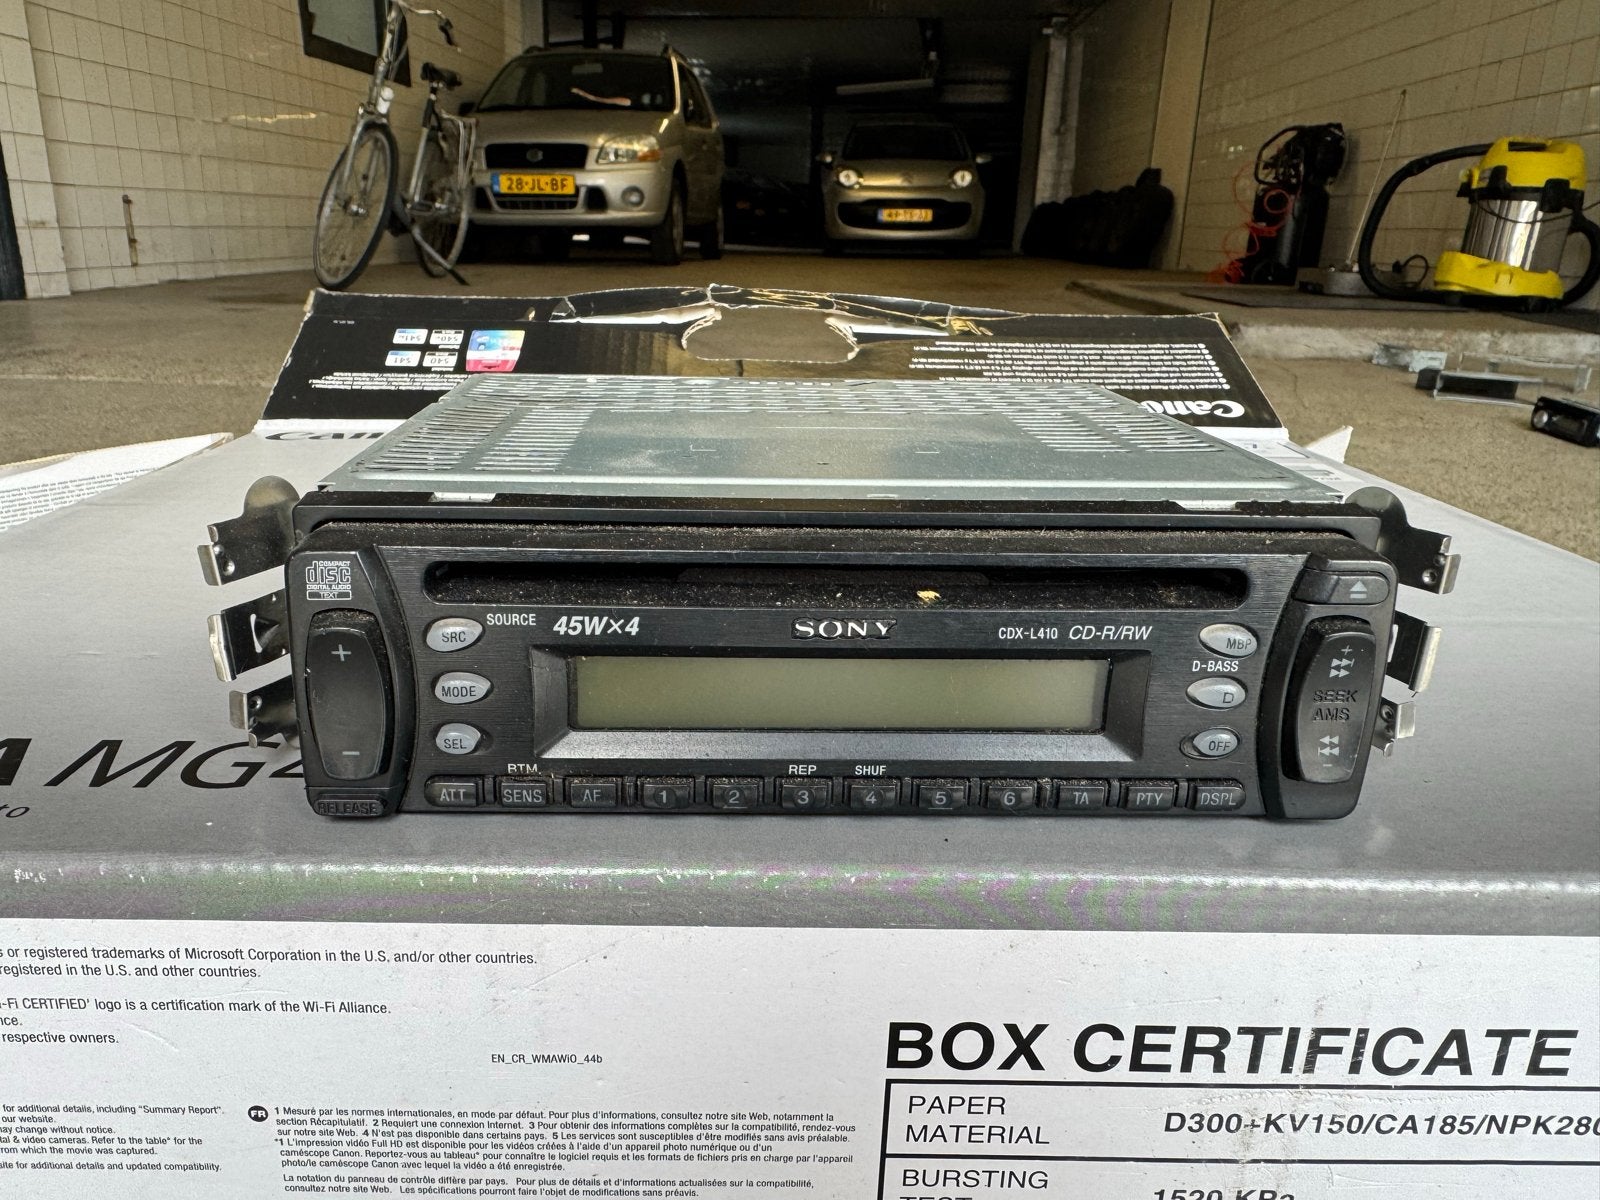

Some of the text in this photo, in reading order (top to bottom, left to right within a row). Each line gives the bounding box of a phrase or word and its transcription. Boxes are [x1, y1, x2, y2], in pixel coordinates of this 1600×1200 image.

[486, 613, 536, 626] SOURCE
[794, 620, 895, 638] SONY
[998, 626, 1153, 640] CDX-L410 CD-R/RW
[442, 631, 466, 643] SRC
[1226, 638, 1252, 650] MBP
[1192, 660, 1239, 672] D-BASS
[442, 685, 476, 698] MODE
[1222, 692, 1234, 704] D
[1314, 690, 1358, 703] SEEK
[1313, 708, 1350, 721] AMS
[444, 738, 467, 749] SEL
[1208, 740, 1231, 752] OFF
[788, 764, 817, 775] REP
[854, 765, 887, 776] SHUF
[440, 788, 466, 802] ATT
[504, 790, 543, 803] SENS
[583, 790, 602, 801] AF
[659, 791, 667, 803] 1
[728, 791, 740, 804] 2
[798, 790, 809, 804] 3
[866, 792, 877, 805] 4
[935, 792, 947, 805] 5
[1004, 794, 1016, 806] 6
[1073, 792, 1089, 805] TA
[1136, 792, 1163, 806] PTY
[1200, 794, 1237, 806] DSPL
[318, 802, 378, 814] RELEASE
[7, 949, 21, 958] or
[23, 946, 89, 961] registered
[90, 946, 166, 959] trademarks
[168, 947, 181, 960] of
[184, 948, 245, 960] Microsoft
[247, 948, 322, 964] Corporation
[325, 949, 337, 961] in
[339, 949, 361, 962] the
[364, 950, 391, 962] U.S.
[393, 950, 436, 962] and/or
[438, 950, 472, 963] other
[475, 951, 538, 964] countries.
[65, 964, 78, 976] in
[80, 964, 102, 976] the
[104, 964, 132, 976] U.S.
[134, 964, 159, 976] and
[162, 964, 195, 977] other
[198, 965, 261, 977] countries.
[94, 998, 122, 1013] logo
[124, 998, 137, 1010] is
[139, 1002, 148, 1011] a
[151, 998, 225, 1011] certification
[228, 999, 262, 1012] mark
[264, 1000, 277, 1012] of
[279, 1000, 301, 1012] the
[302, 1000, 336, 1013] Wi-Fi
[338, 1001, 392, 1013] Alliance.
[1, 1030, 119, 1046] respective owners.
[886, 1022, 1579, 1077] BOX CERTIFICATE
[2, 1103, 16, 1112] for
[17, 1104, 61, 1113] additional
[62, 1104, 95, 1115] details,
[96, 1104, 137, 1115] including
[908, 1096, 1006, 1115] PAPER
[18, 1114, 57, 1123] website.
[274, 1107, 280, 1115] 1
[282, 1107, 317, 1116] Mesuré
[318, 1109, 334, 1118] par
[335, 1107, 350, 1116] les
[471, 1109, 498, 1117] mode
[498, 1111, 514, 1120] par
[515, 1109, 547, 1118] défaut.
[548, 1109, 570, 1118] Pour
[571, 1110, 591, 1120] plus
[705, 1111, 729, 1120] notre
[730, 1111, 747, 1120] site
[748, 1112, 771, 1122] Web,
[826, 1112, 834, 1121] la
[14, 1125, 49, 1135] change
[49, 1125, 85, 1134] without
[85, 1125, 116, 1134] notice.
[906, 1125, 1050, 1145] MATERIAL
[20, 1145, 48, 1154] which
[49, 1145, 64, 1154] the
[66, 1146, 93, 1154] movie
[115, 1146, 158, 1157] captured.
[15, 1160, 29, 1169] for
[30, 1160, 74, 1169] additional
[75, 1161, 106, 1170] details
[106, 1161, 124, 1170] and
[125, 1161, 162, 1172] updated
[163, 1162, 222, 1173] compatibility.
[902, 1169, 1049, 1189] BURSTING
[328, 1184, 351, 1192] notre
[352, 1184, 369, 1193] site
[369, 1184, 393, 1193] Web.
[399, 1184, 416, 1193] Les
[517, 1186, 538, 1195] faire
[539, 1186, 567, 1197] l'objet
[568, 1186, 580, 1195] de
